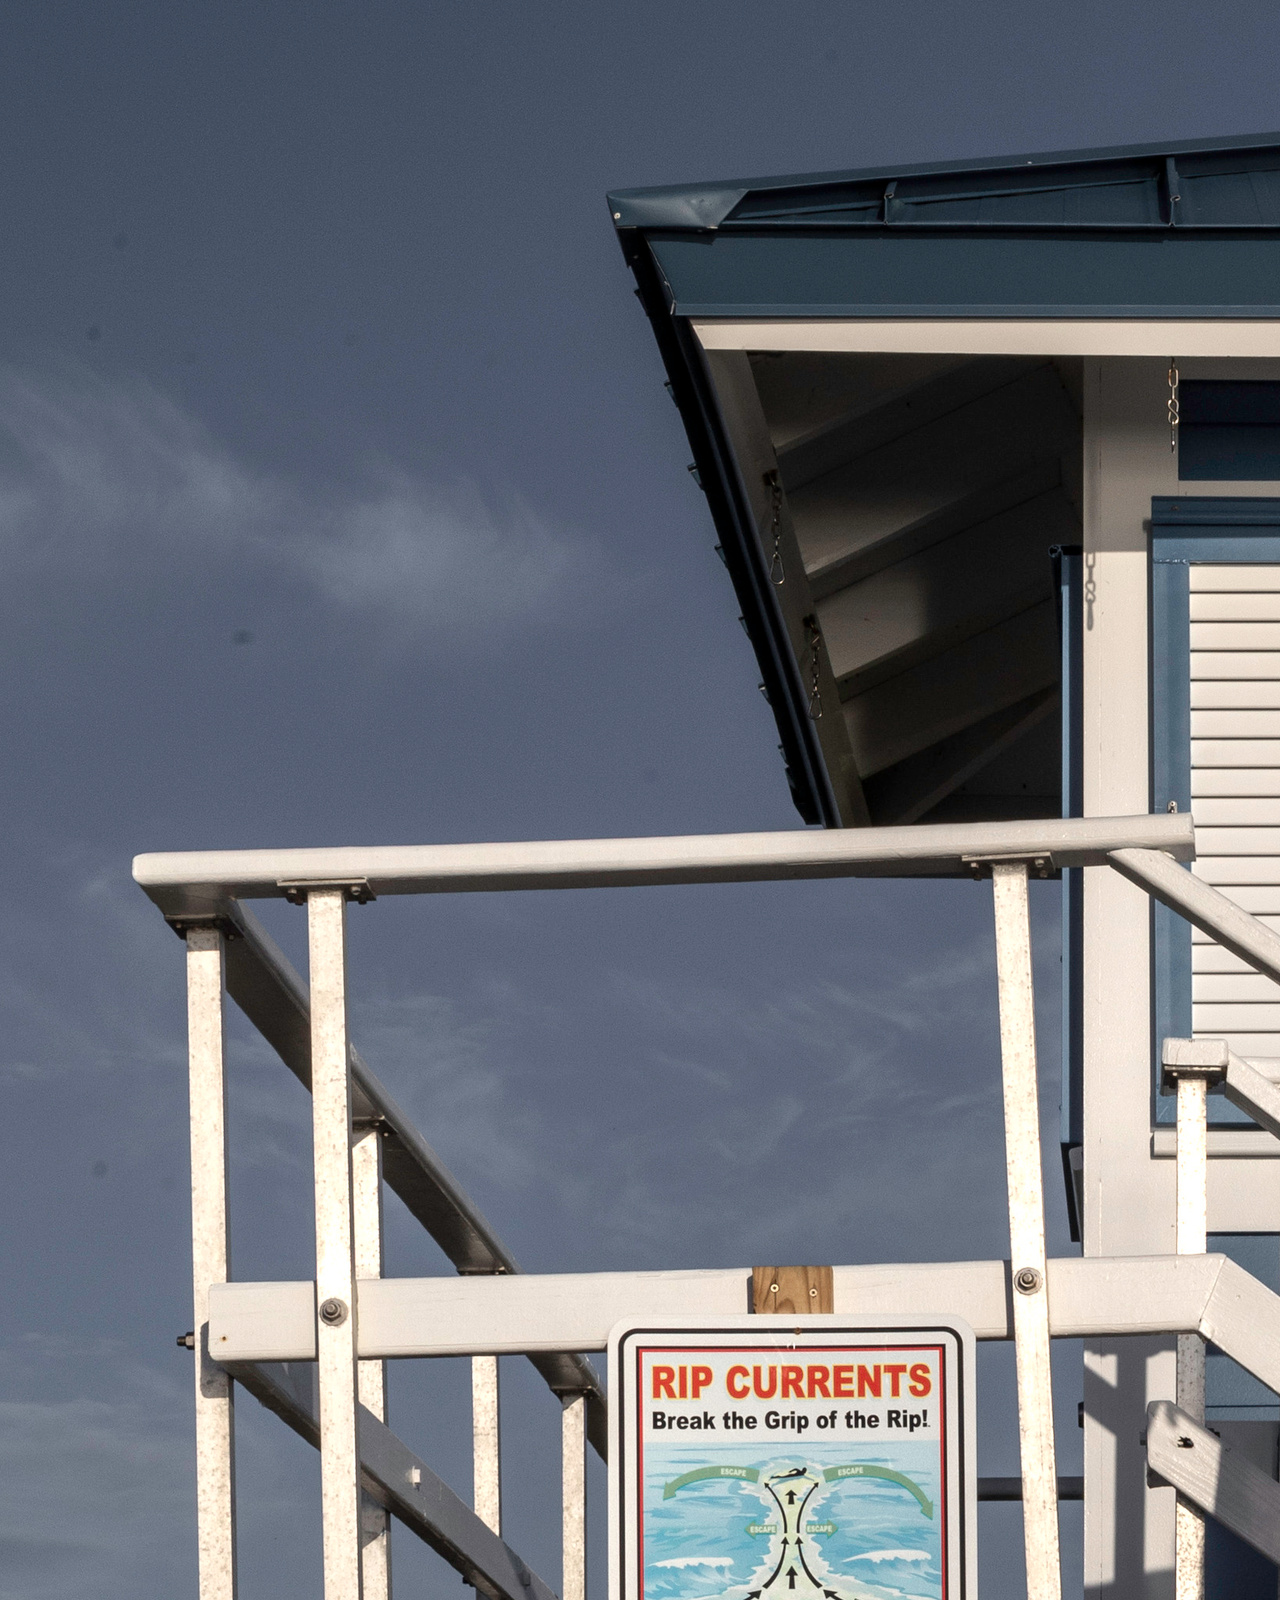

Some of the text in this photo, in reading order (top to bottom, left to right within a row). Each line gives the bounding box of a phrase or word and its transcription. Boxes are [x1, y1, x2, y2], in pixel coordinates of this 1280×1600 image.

[651, 1363, 933, 1400] RIP CURRENTS
[653, 1410, 929, 1433] Break the Grip of the Rip!
[720, 1468, 747, 1477] ESCAPE
[837, 1467, 864, 1476] ESCAPE
[806, 1525, 833, 1533] ESCAPE
